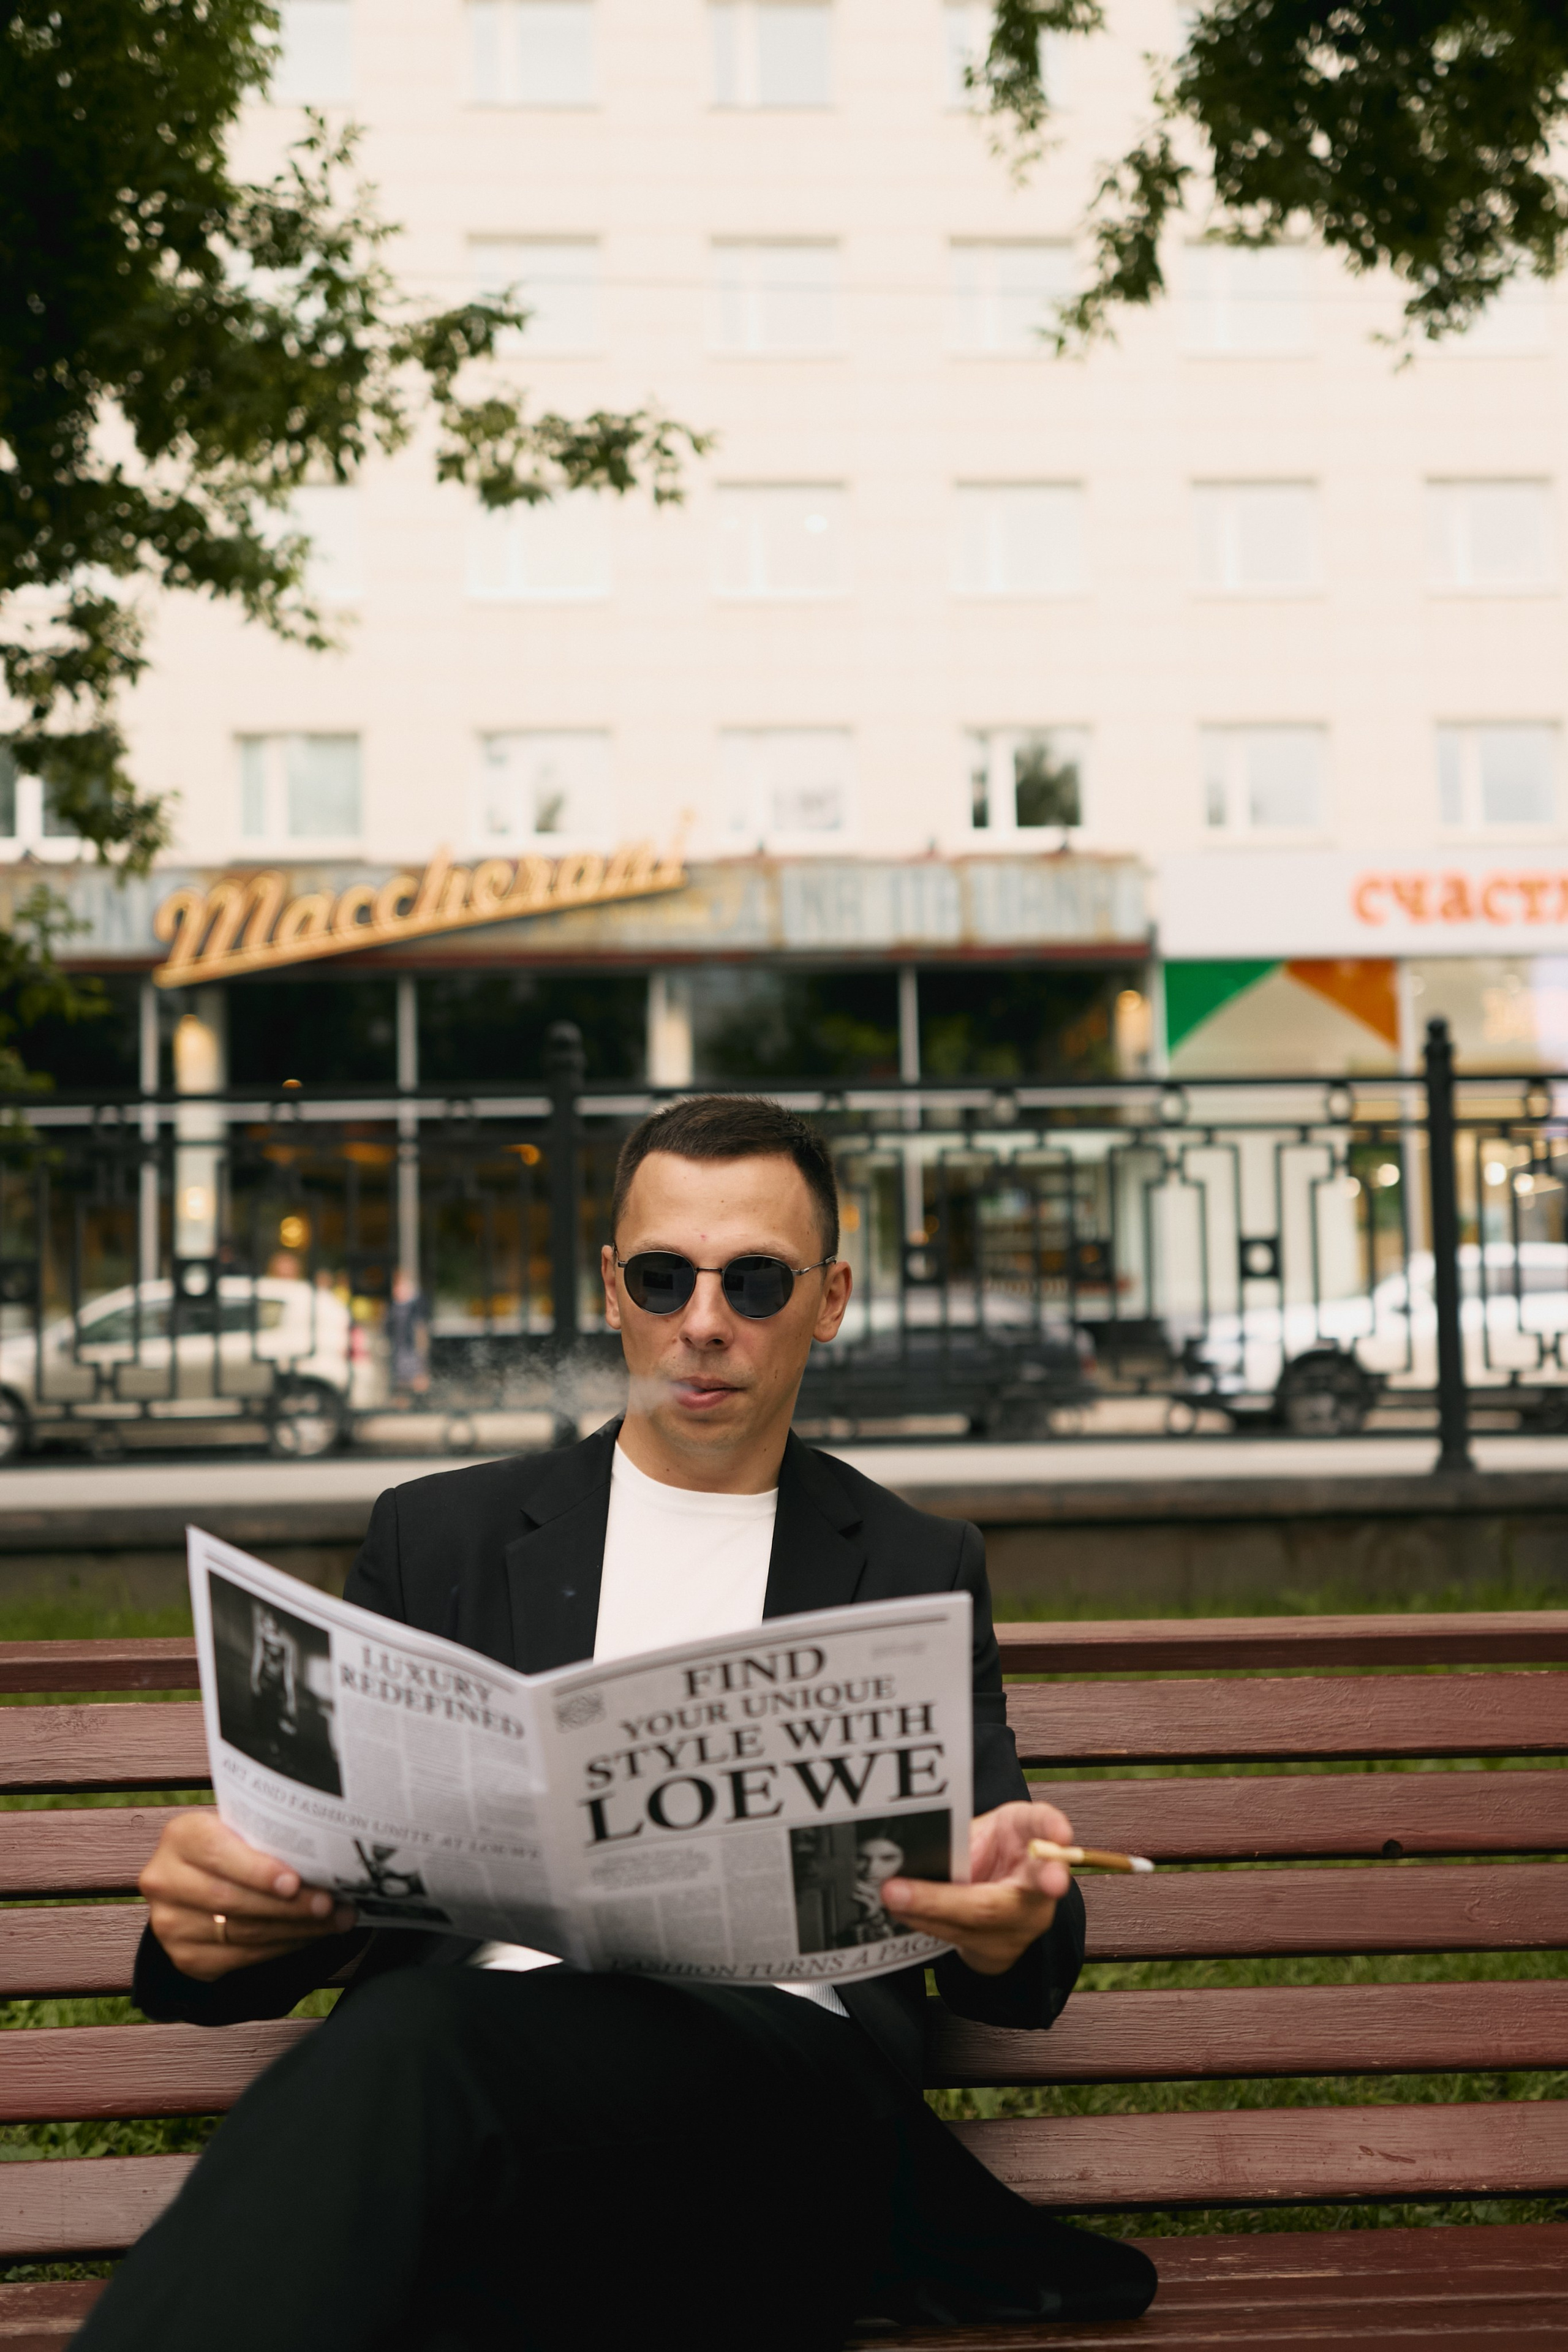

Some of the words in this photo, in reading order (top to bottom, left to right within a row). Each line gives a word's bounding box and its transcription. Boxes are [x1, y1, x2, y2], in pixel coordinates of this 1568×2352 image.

[154, 807, 696, 974] Maccheroni
[340, 1662, 525, 1740] REDEFINED
[361, 1645, 491, 1703] LUXURY
[620, 1702, 729, 1741] YOUR
[742, 1676, 896, 1719] UNIQUE
[682, 1646, 826, 1698] FIND
[584, 1724, 766, 1790] STYLE
[780, 1700, 937, 1752] WITH
[222, 1757, 247, 1780] ART
[251, 1777, 287, 1803] AND
[288, 1792, 369, 1829] FASHION
[372, 1820, 430, 1844] UNITE
[442, 1838, 462, 1848] AT
[578, 1743, 949, 1845] LOEWE
[745, 1954, 846, 1978] TURNS
[852, 1950, 869, 1965] A
